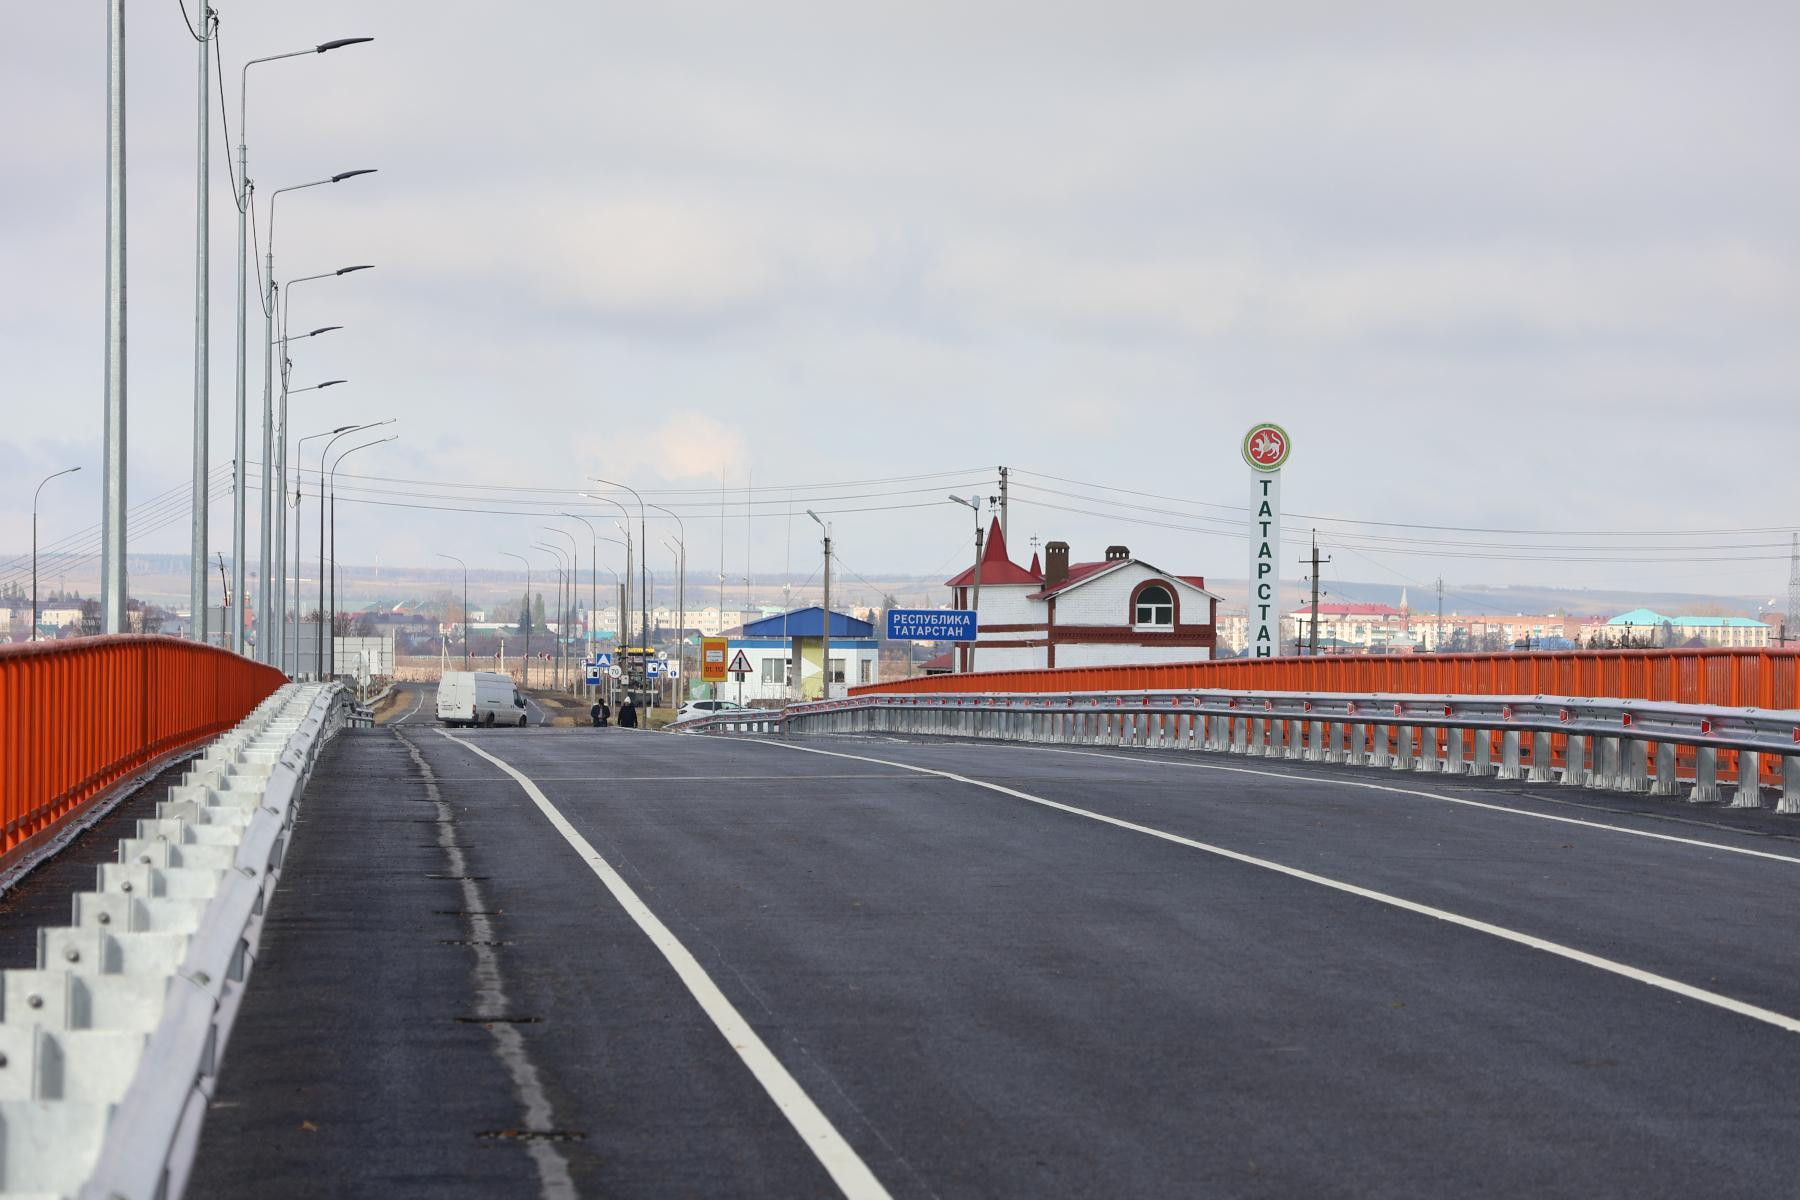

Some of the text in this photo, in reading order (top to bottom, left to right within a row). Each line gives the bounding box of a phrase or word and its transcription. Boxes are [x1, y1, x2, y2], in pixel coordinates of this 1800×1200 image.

[1256, 480, 1273, 658] ТАТАРСТАН
[893, 614, 971, 625] РЕСПУБЛИКА
[893, 626, 963, 636] ТАТАРСТАН
